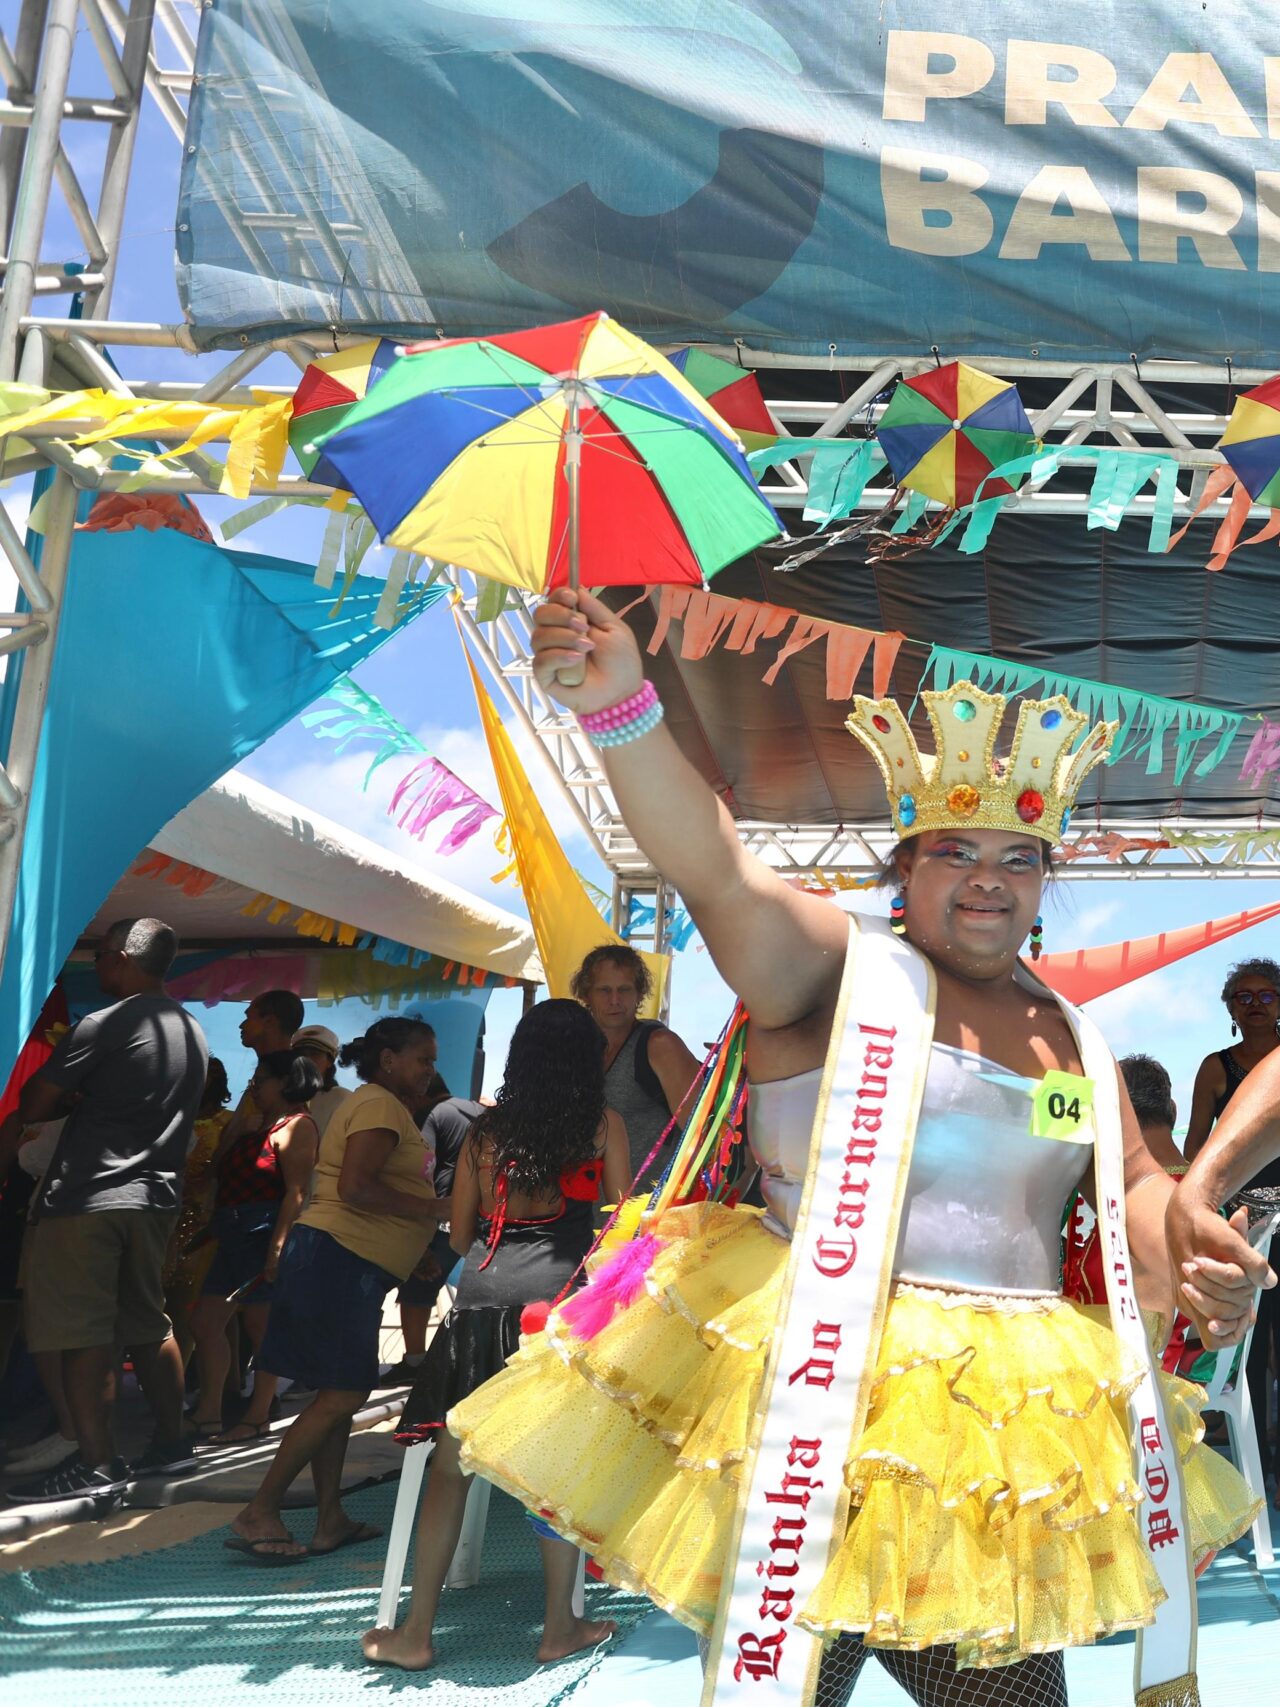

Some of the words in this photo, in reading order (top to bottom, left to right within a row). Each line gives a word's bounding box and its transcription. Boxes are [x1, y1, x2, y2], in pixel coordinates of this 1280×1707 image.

[812, 1022, 898, 1279] Carnaval
[1048, 1092, 1081, 1123] 04
[788, 1319, 843, 1392] do
[1140, 1416, 1180, 1552] PCD
[732, 1434, 825, 1683] Rainha
